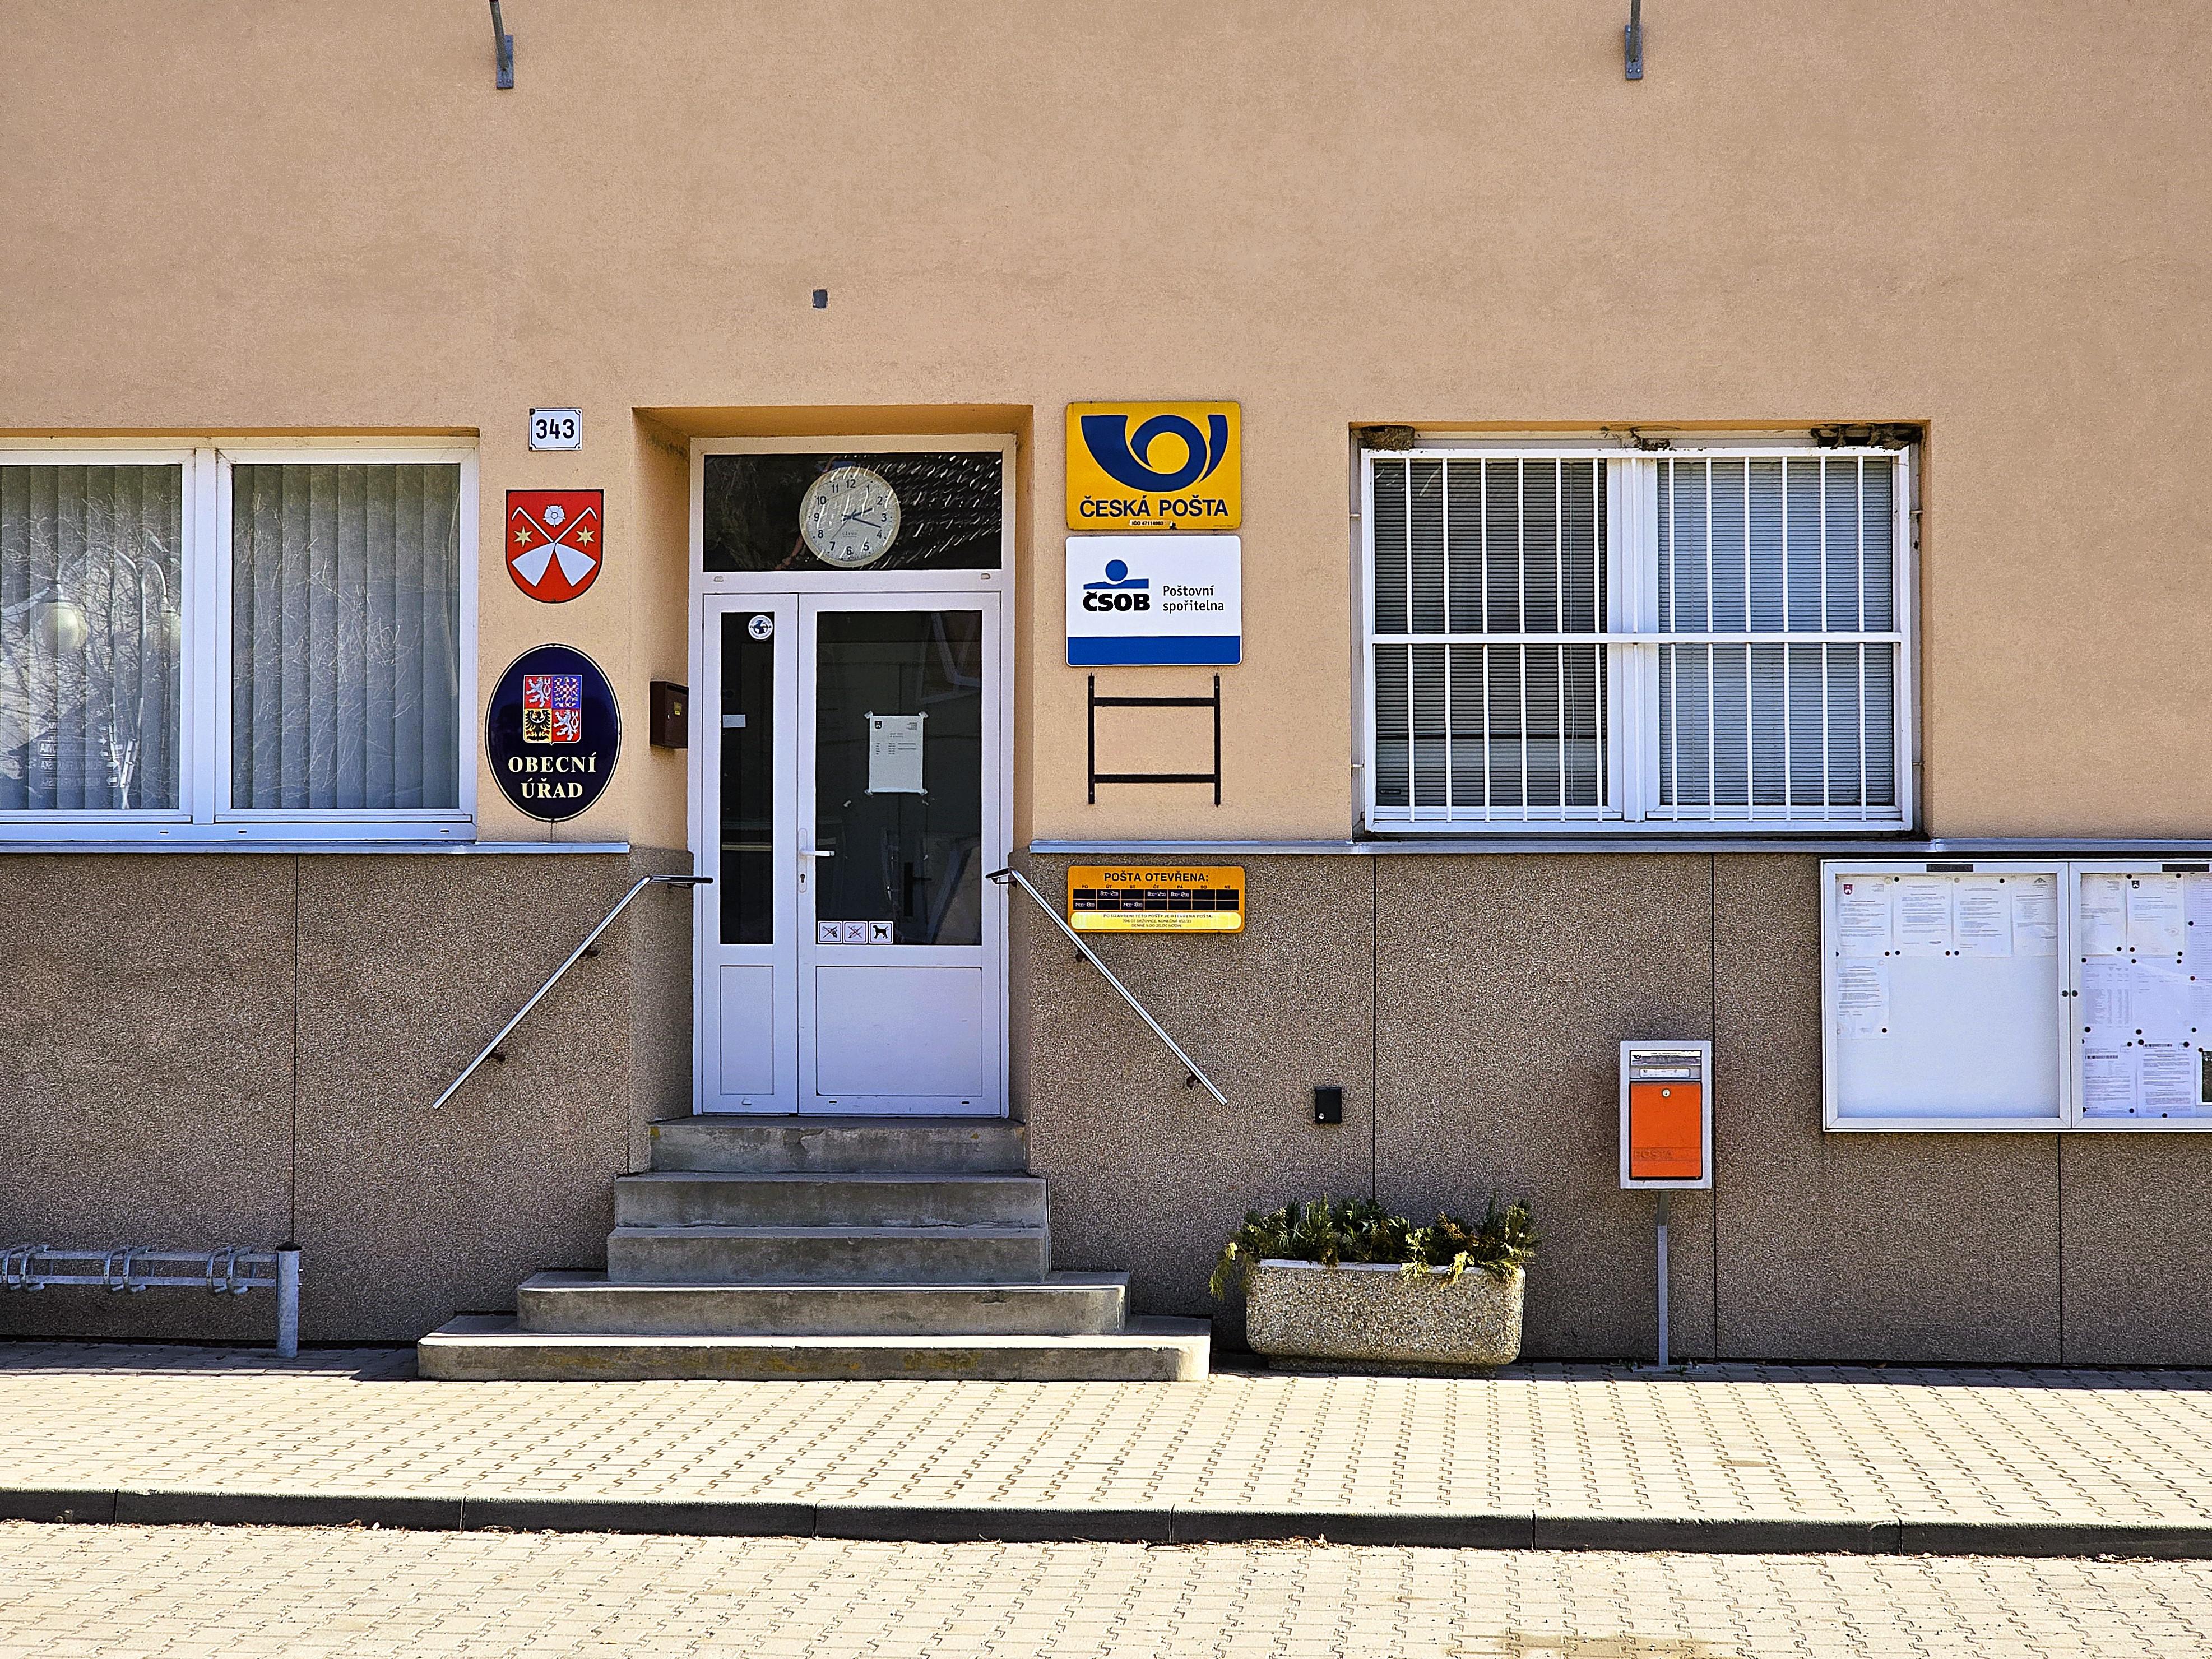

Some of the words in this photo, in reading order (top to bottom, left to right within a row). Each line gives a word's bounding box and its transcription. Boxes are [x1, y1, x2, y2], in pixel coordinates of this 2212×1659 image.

[536, 419, 574, 439] 343
[846, 479, 856, 488] 12
[832, 484, 838, 493] 11
[816, 495, 827, 504] 10
[877, 496, 883, 505] 2
[1079, 495, 1151, 517] ČESKÁ
[1159, 494, 1228, 517] POŠTA
[814, 513, 820, 522] 9
[881, 513, 887, 522] 3
[818, 529, 824, 538] 8
[877, 530, 882, 539] 4
[829, 541, 836, 551] 7
[846, 546, 852, 555] 6
[864, 542, 870, 551] 5
[1163, 585, 1214, 596] Poštovní
[1083, 591, 1151, 611] ČSOB
[1163, 600, 1225, 614] spořitelna
[508, 752, 597, 772] OBECNÍ
[521, 778, 583, 798] ÚŘAD
[1104, 870, 1142, 882] POŠTA
[1145, 870, 1209, 882] OTEVŘENA:
